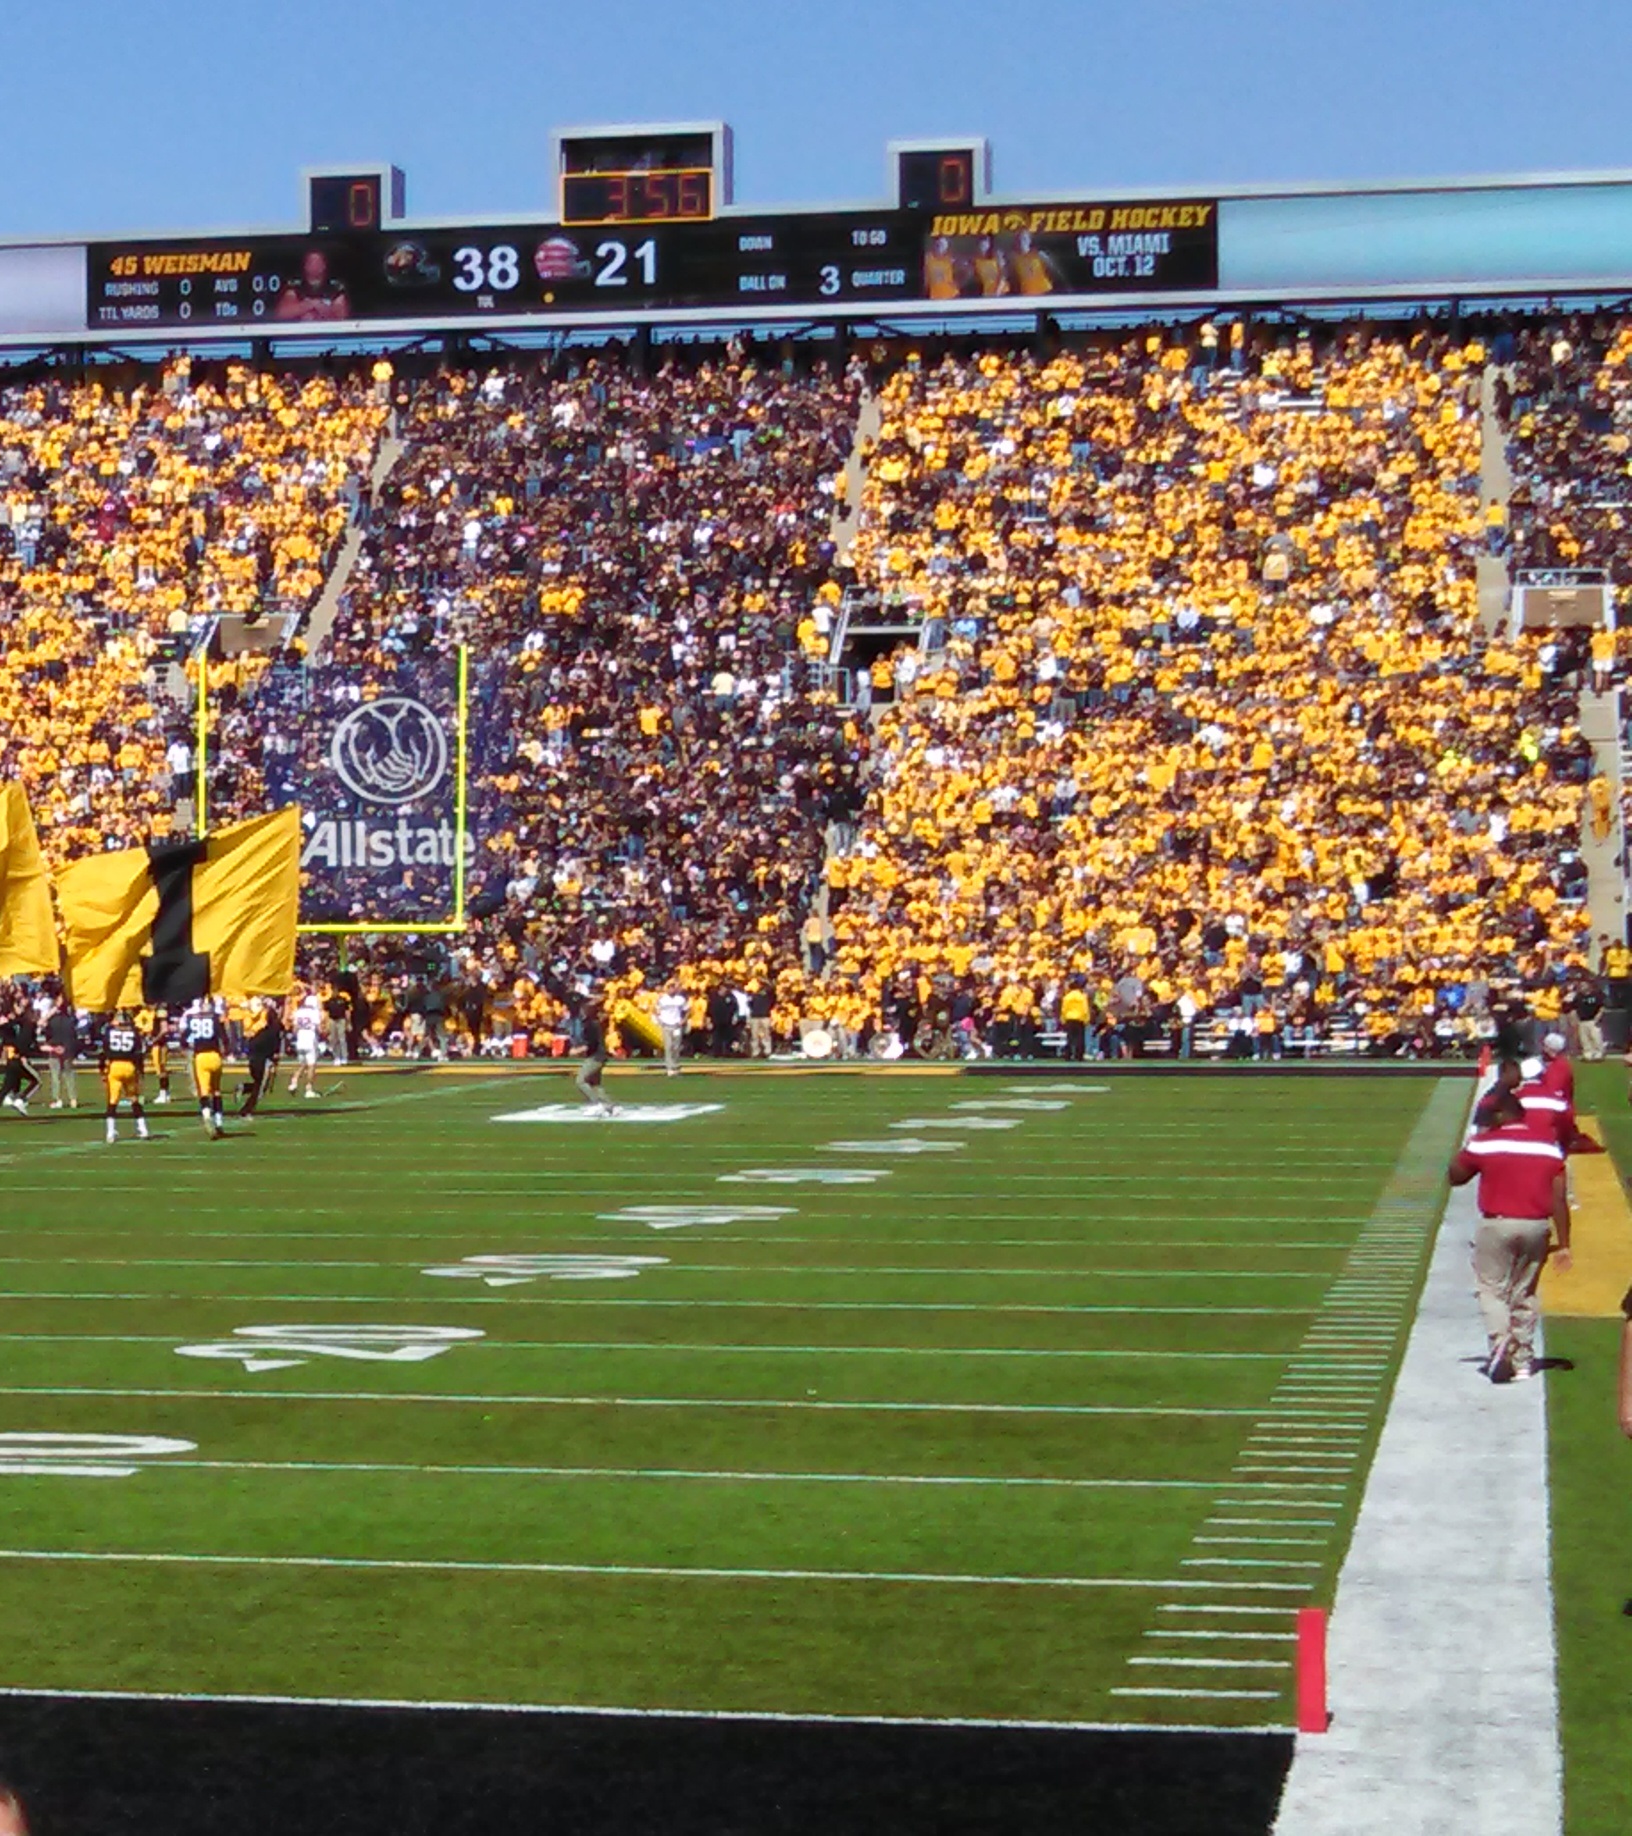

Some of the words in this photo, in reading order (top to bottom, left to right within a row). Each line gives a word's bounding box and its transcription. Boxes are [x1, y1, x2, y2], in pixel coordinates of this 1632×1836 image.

[350, 183, 372, 227] 0
[930, 213, 1000, 237] IOWA
[1028, 209, 1106, 233] FIELD
[1110, 205, 1212, 230] HOCKEY
[1077, 235, 1103, 257] VS.
[1107, 232, 1171, 254] MIAMI
[110, 255, 138, 276] 45
[143, 252, 252, 275] WEISMAN
[452, 245, 519, 291] 38
[595, 240, 657, 287] 21
[1092, 256, 1130, 278] OCT.
[1134, 255, 1155, 277] 12
[104, 281, 160, 297] RUSHING
[179, 278, 192, 296] 0
[819, 265, 841, 295] 3
[99, 307, 119, 320] TTL
[121, 305, 160, 320] YARDS
[179, 301, 192, 319] 0
[252, 299, 265, 316] 0
[301, 817, 476, 868] Allstate
[142, 838, 211, 1003] I
[188, 1017, 215, 1039] 98
[108, 1031, 135, 1052] 55
